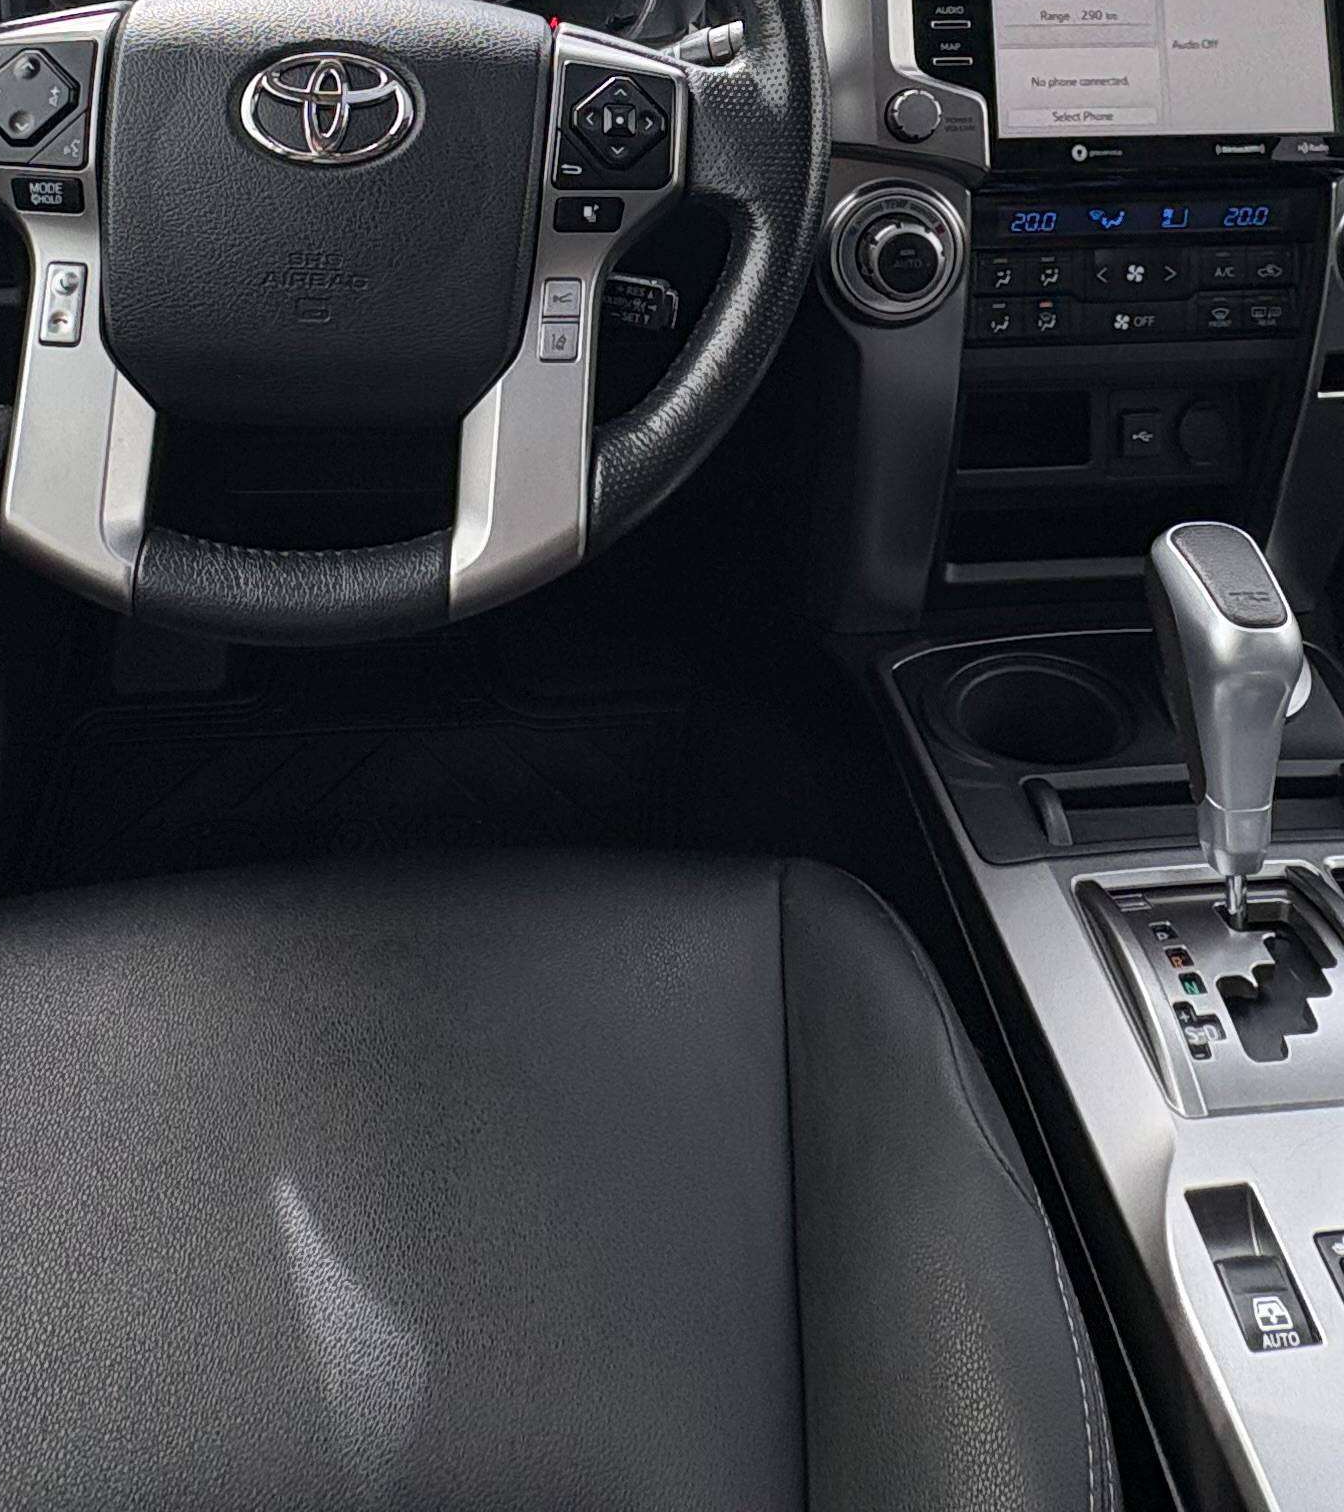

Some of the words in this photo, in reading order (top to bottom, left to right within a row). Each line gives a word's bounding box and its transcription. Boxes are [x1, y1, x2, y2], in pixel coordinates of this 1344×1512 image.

[935, 6, 965, 15] AUDIO
[1040, 11, 1071, 24] Range
[1081, 10, 1103, 21] 290
[940, 43, 961, 51] MAP
[1172, 39, 1200, 50] Audio
[1201, 39, 1219, 49] Off
[1031, 76, 1046, 87] No
[1048, 76, 1078, 90] phone
[1052, 111, 1081, 122] Select
[1083, 111, 1114, 122] Phone
[29, 182, 63, 194] MODE
[39, 194, 63, 205] HOLD
[1010, 212, 1057, 232] 20.0
[1223, 206, 1269, 227] 20.0
[894, 258, 922, 268] AUTO
[1214, 266, 1235, 278] A/C
[1133, 315, 1156, 327] OFF
[1156, 930, 1169, 942] P
[1171, 955, 1184, 969] R
[1184, 980, 1201, 995] N
[1262, 1331, 1301, 1349] AUTO
